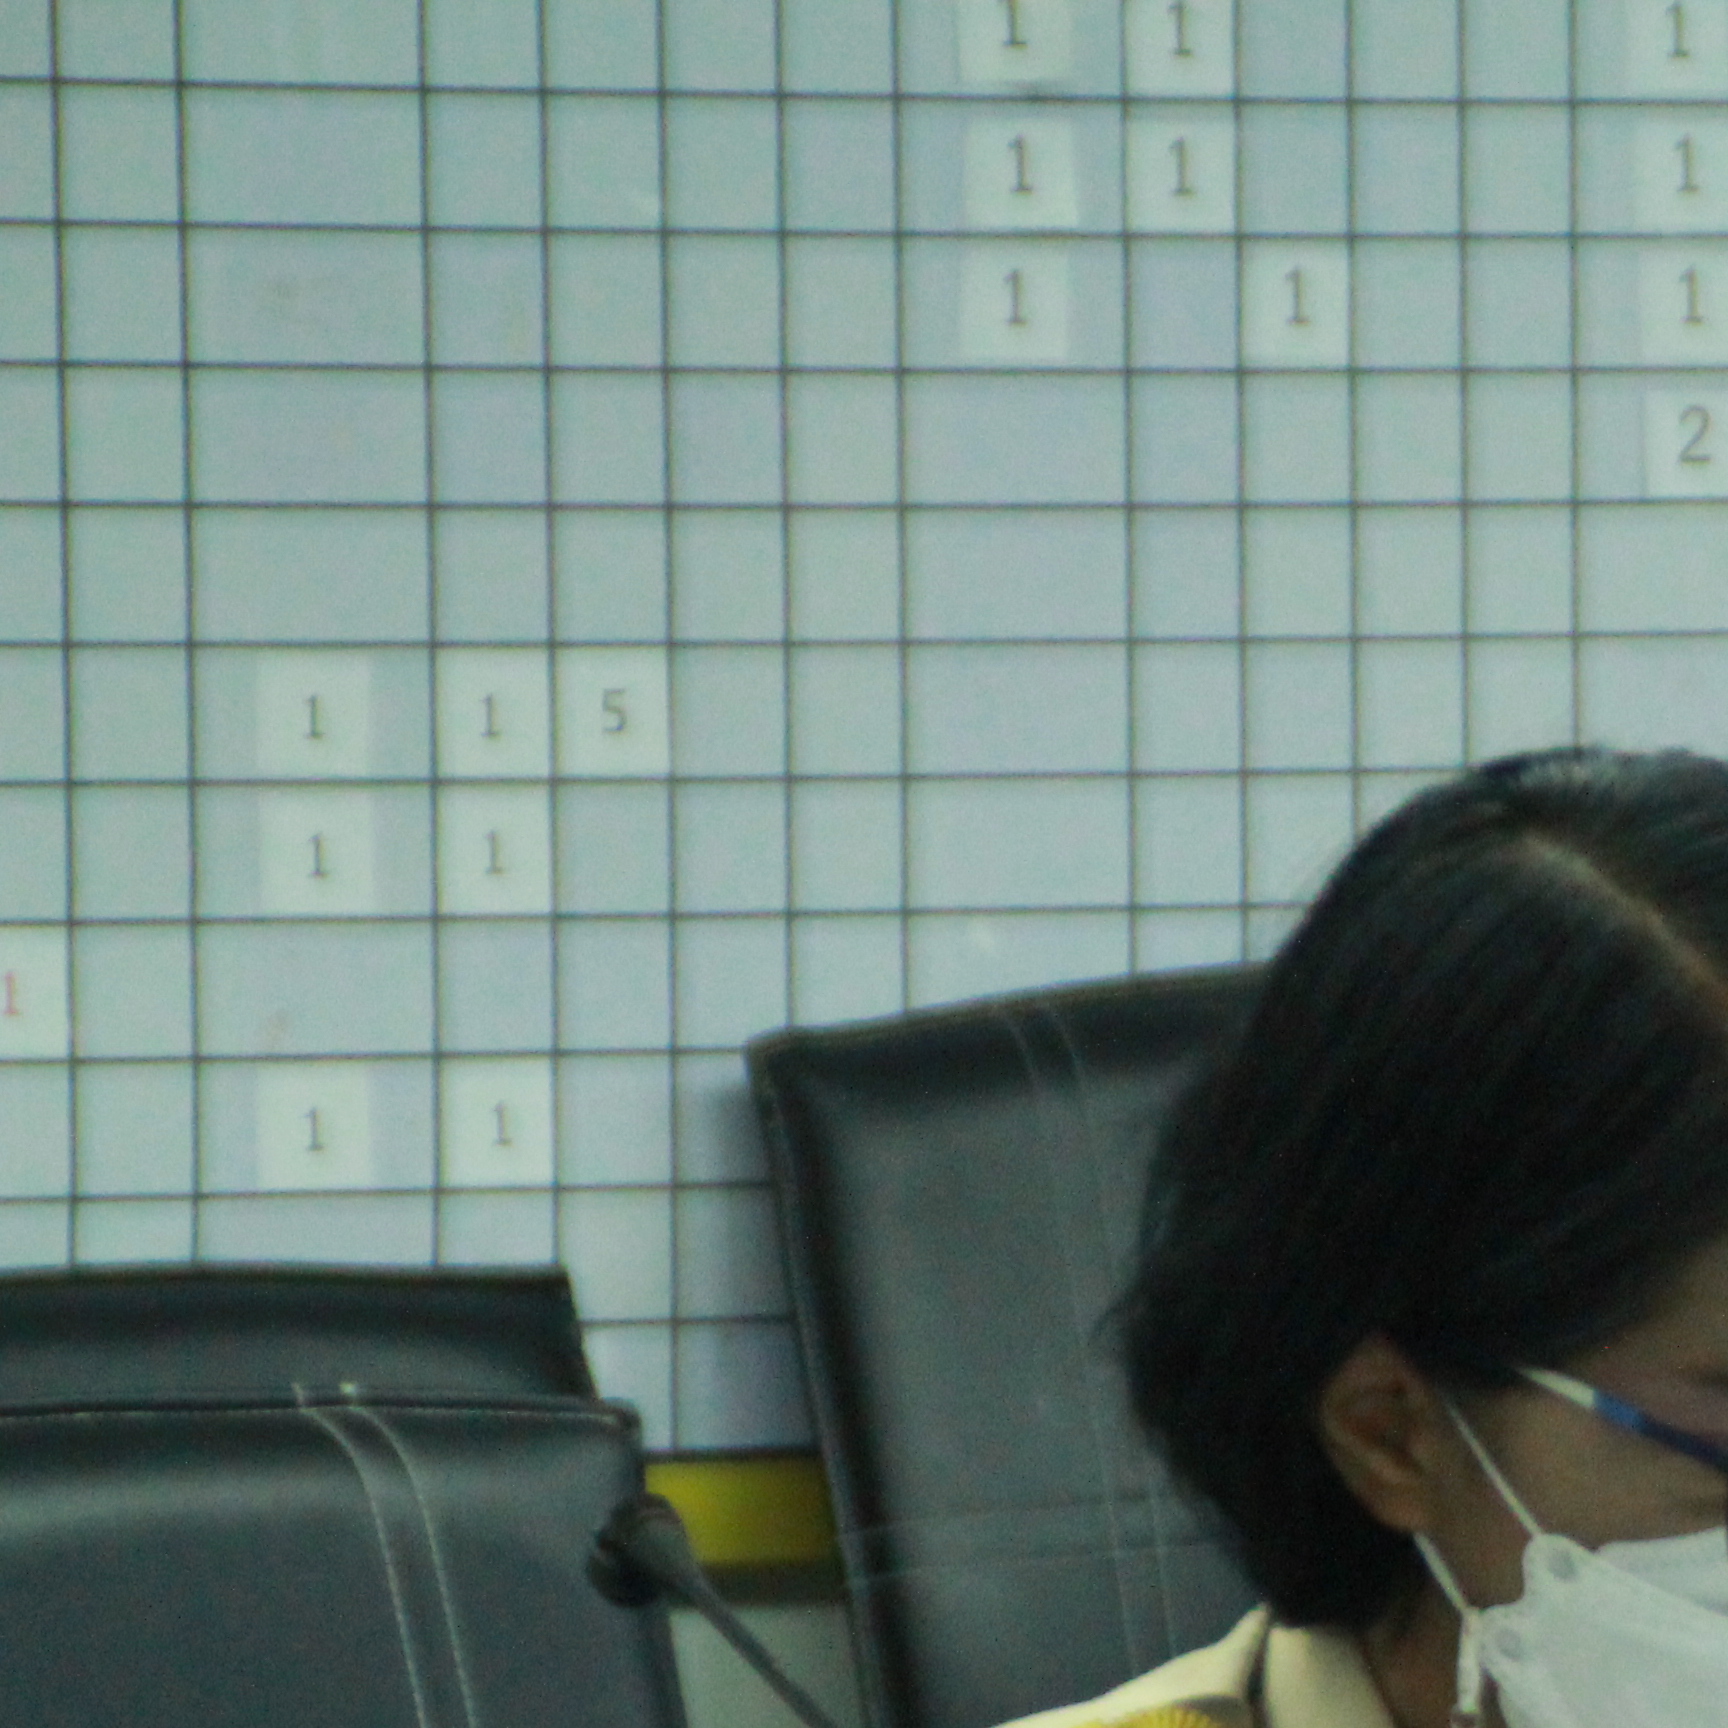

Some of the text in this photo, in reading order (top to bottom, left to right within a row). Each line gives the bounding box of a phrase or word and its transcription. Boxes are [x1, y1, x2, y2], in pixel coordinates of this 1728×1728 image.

[1000, 0, 1194, 60] 1 1
[1667, 0, 1692, 61] 1
[1008, 135, 1197, 200] 1 1
[1675, 135, 1701, 197] 1
[1004, 267, 1029, 329] 1
[1286, 267, 1312, 329] 1
[1679, 266, 1705, 328] 1
[1678, 404, 1712, 469] 2
[306, 688, 630, 743] 1 1 5
[310, 829, 508, 882] 1 1
[2, 970, 22, 1018] 1
[307, 1102, 514, 1155] 1 1
